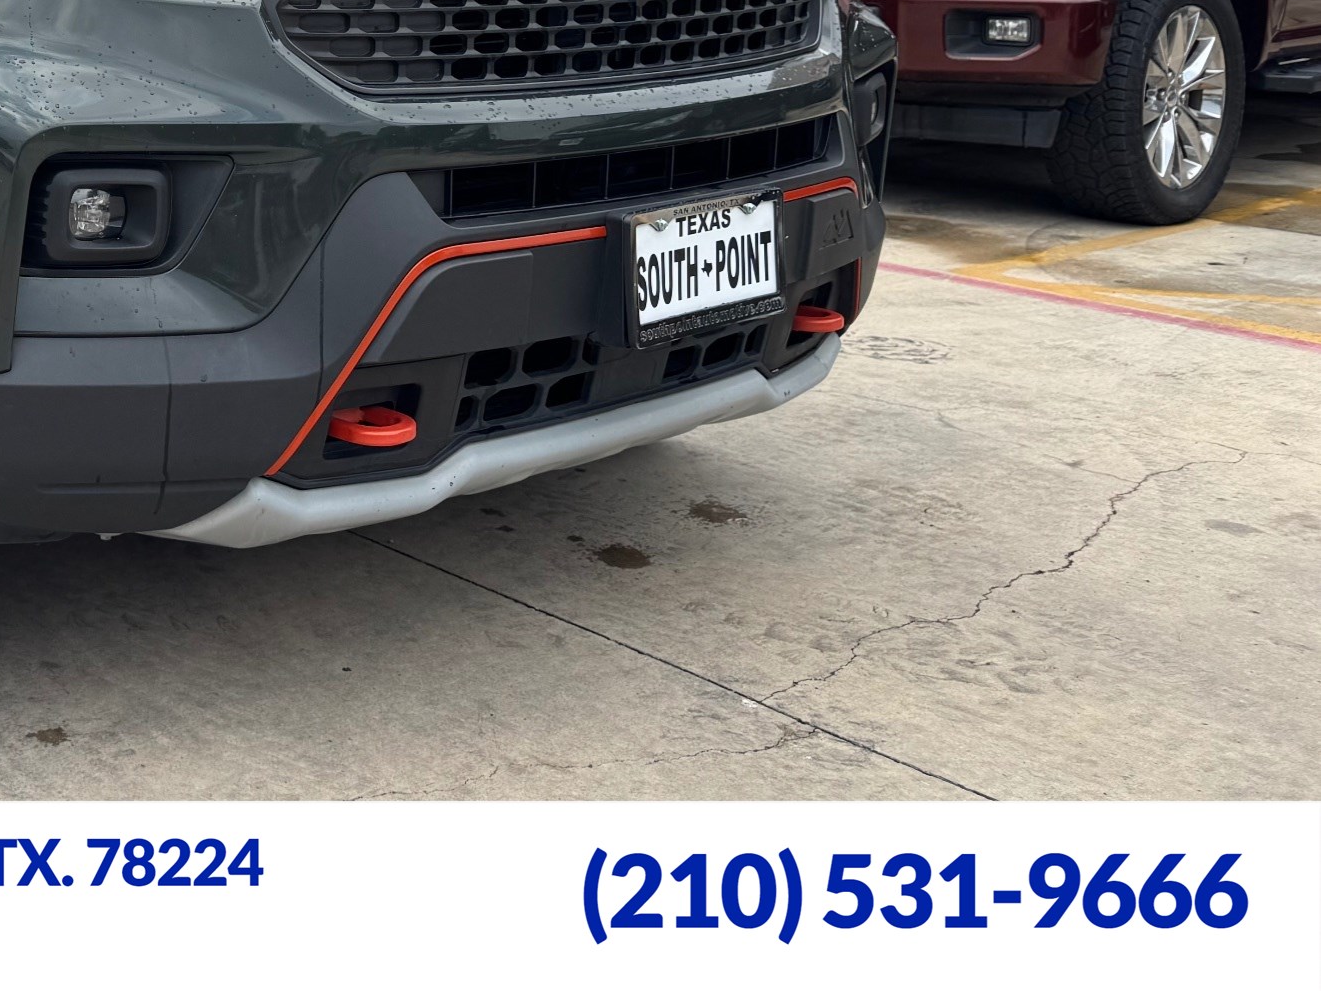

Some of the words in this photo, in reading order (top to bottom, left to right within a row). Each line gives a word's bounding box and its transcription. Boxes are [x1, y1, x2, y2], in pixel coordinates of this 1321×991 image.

[672, 207, 690, 216] SAN
[675, 208, 731, 238] TEXAS
[637, 244, 699, 312] SOUTH
[715, 230, 772, 292] POINT
